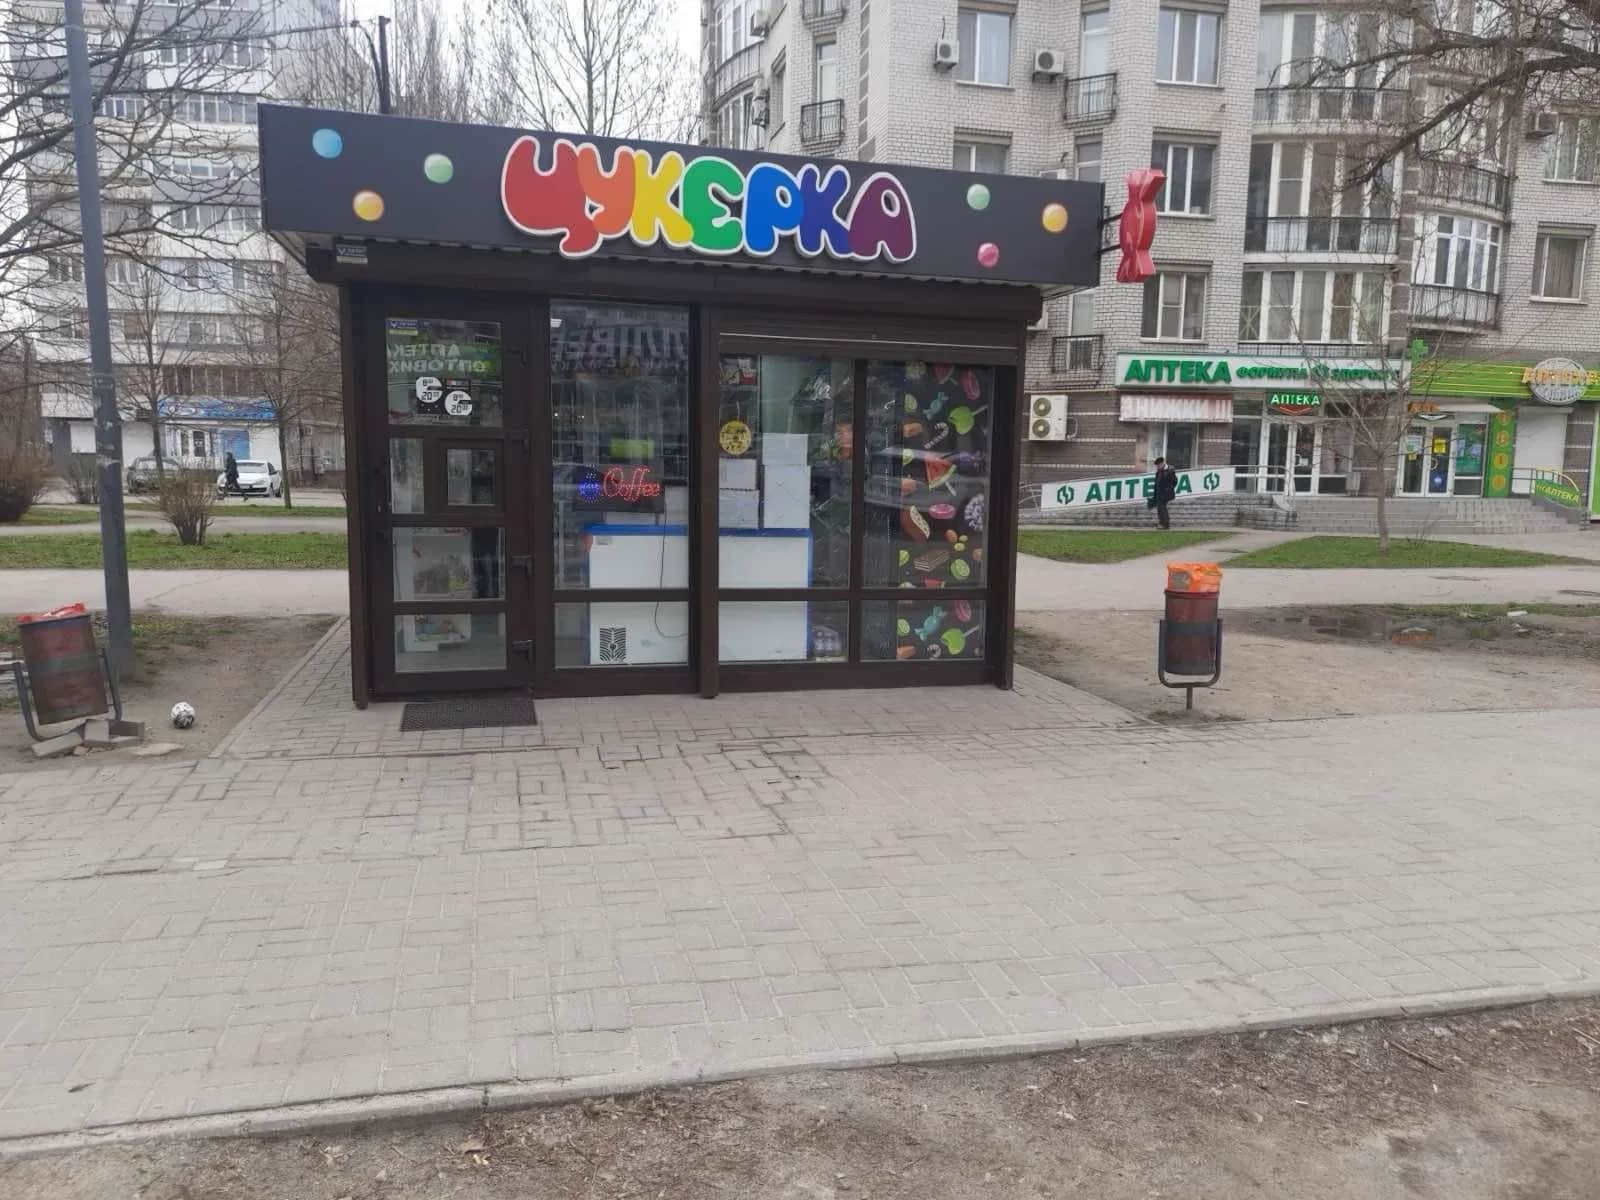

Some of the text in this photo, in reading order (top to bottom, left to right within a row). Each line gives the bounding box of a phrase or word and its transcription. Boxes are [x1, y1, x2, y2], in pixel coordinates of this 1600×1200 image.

[502, 135, 917, 262] ЦУКЕРКА
[1124, 359, 1231, 384] АПТЕКА
[1270, 393, 1321, 405] АПТЕКА
[603, 466, 661, 501] Coffee
[1085, 473, 1192, 503] АПТЕА
